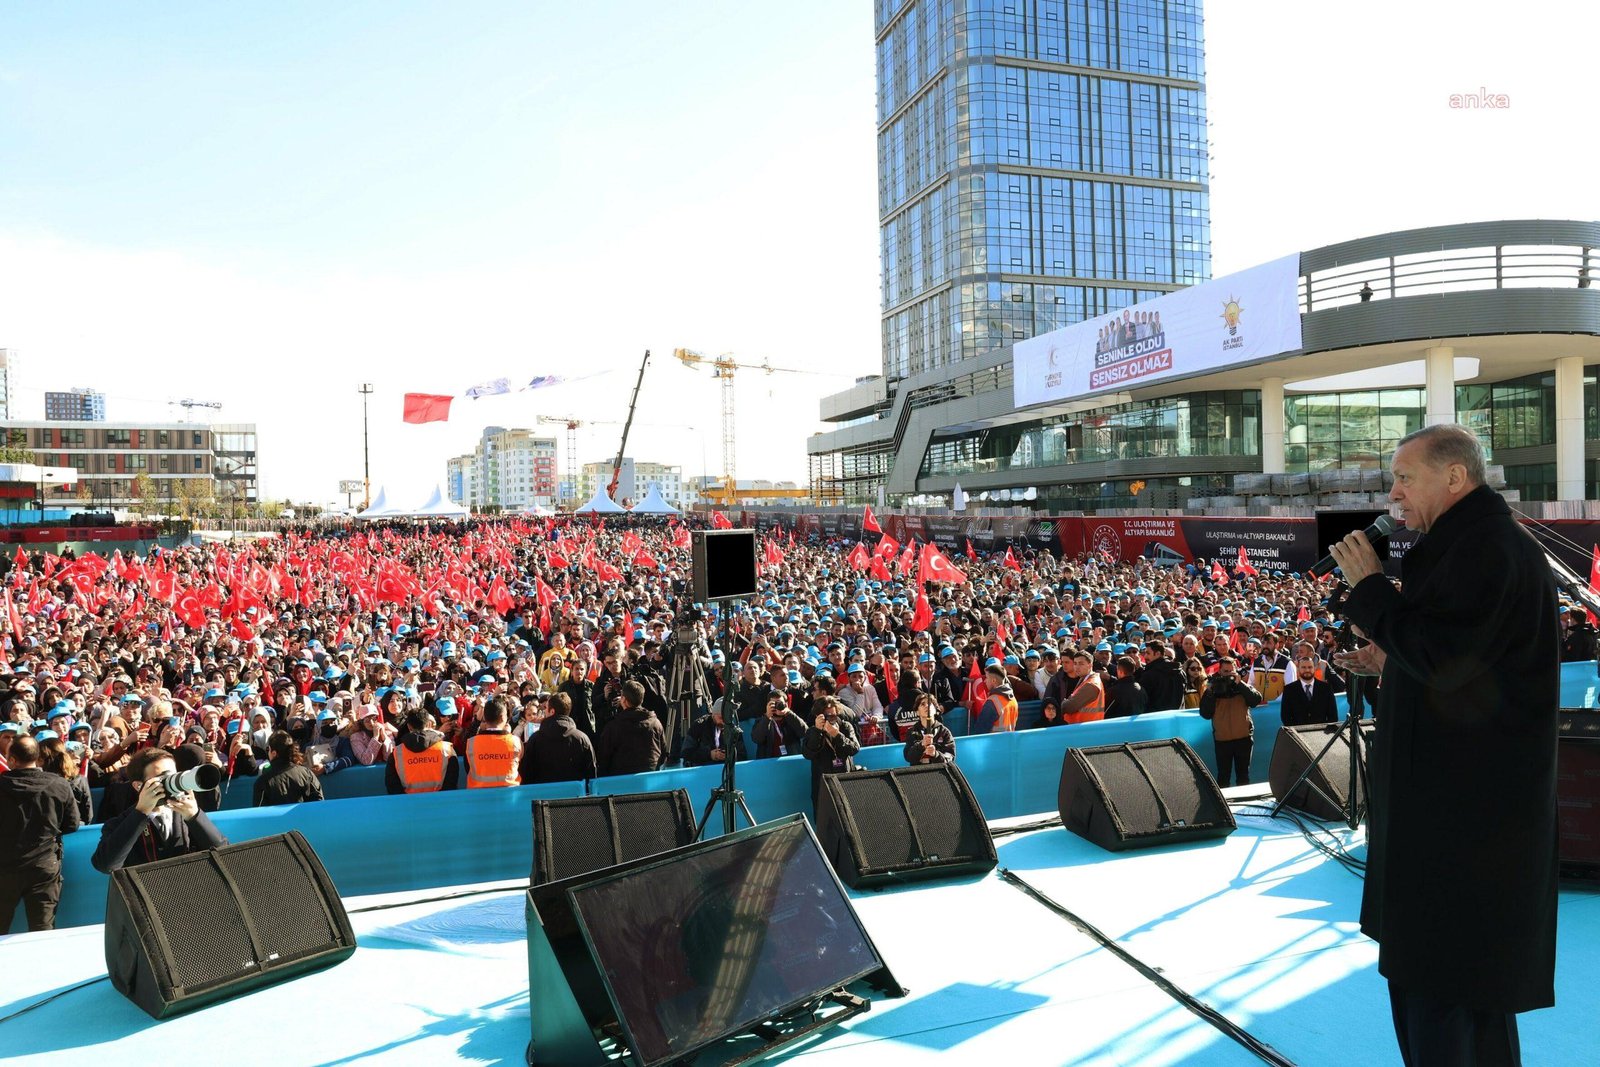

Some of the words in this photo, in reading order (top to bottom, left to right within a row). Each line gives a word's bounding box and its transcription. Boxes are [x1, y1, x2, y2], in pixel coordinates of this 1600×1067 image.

[1136, 336, 1162, 354] OLDU
[1130, 353, 1170, 375] OLMAZ
[1146, 529, 1175, 537] BAKANLIĞI
[1266, 533, 1296, 541] BAKANLIĞI
[1220, 546, 1237, 556] ŞEHİR
[407, 756, 439, 765] GÖREVLİ
